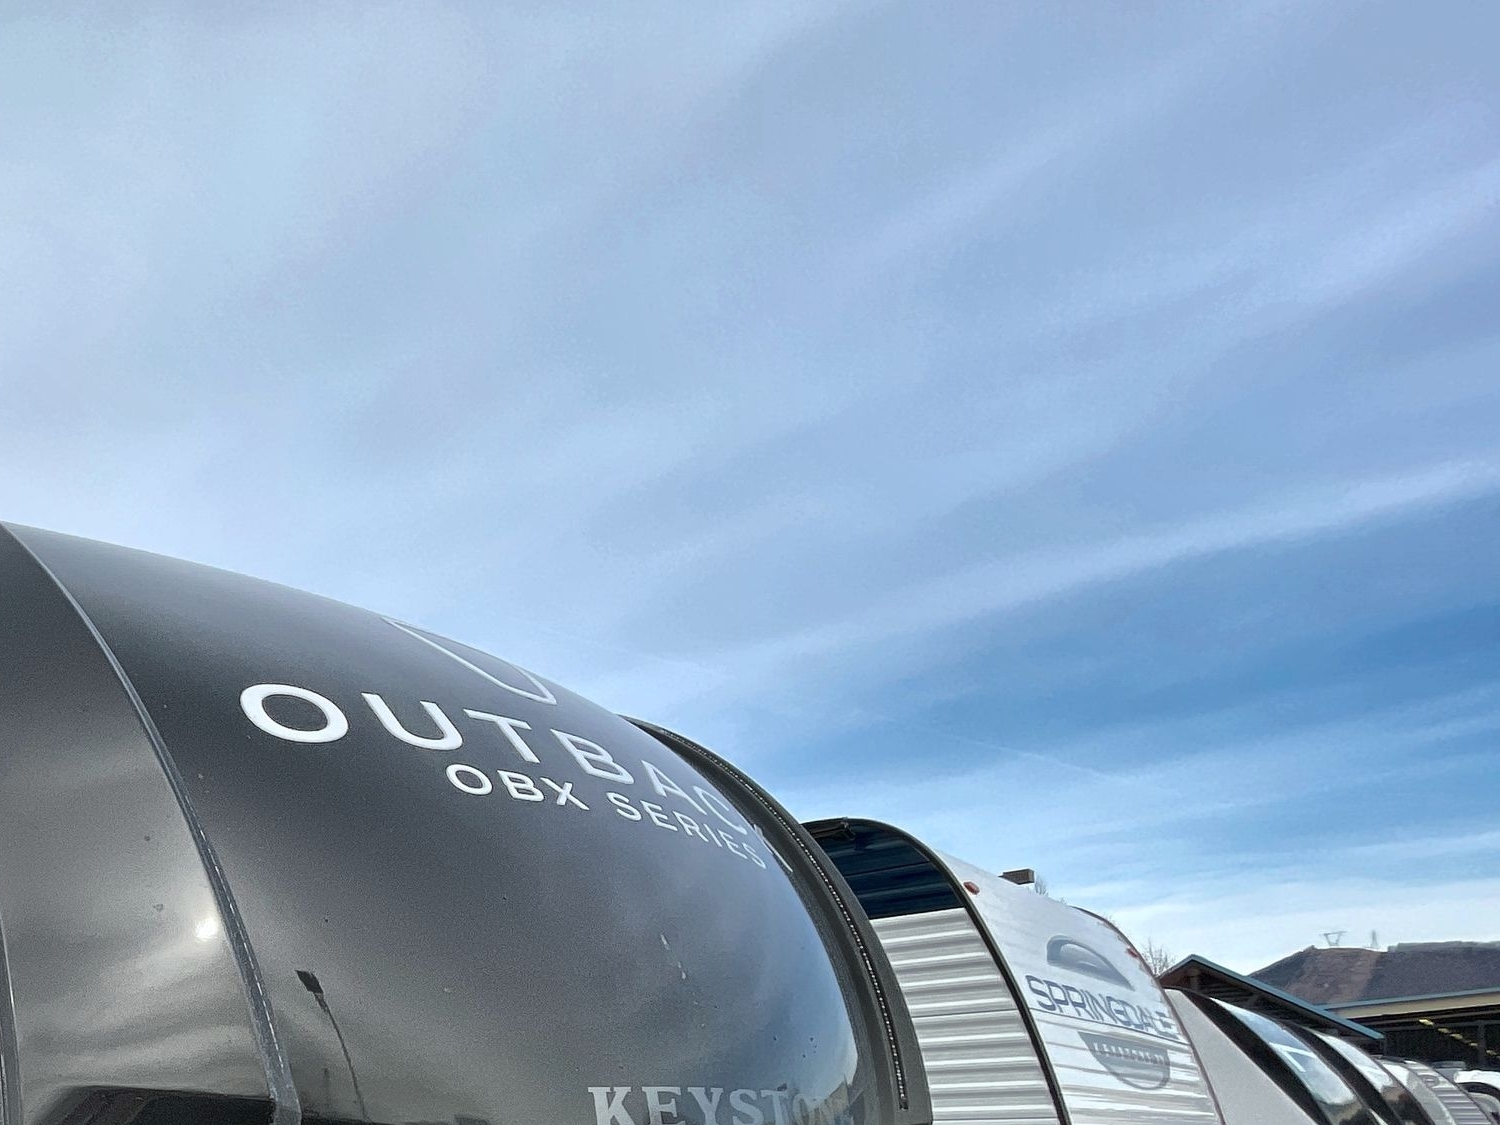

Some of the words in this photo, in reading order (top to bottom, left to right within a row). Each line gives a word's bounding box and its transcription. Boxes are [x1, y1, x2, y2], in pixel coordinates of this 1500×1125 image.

[446, 763, 590, 811] OBX
[606, 792, 767, 869] SERIES
[1025, 974, 1180, 1040] SPRINGDALE
